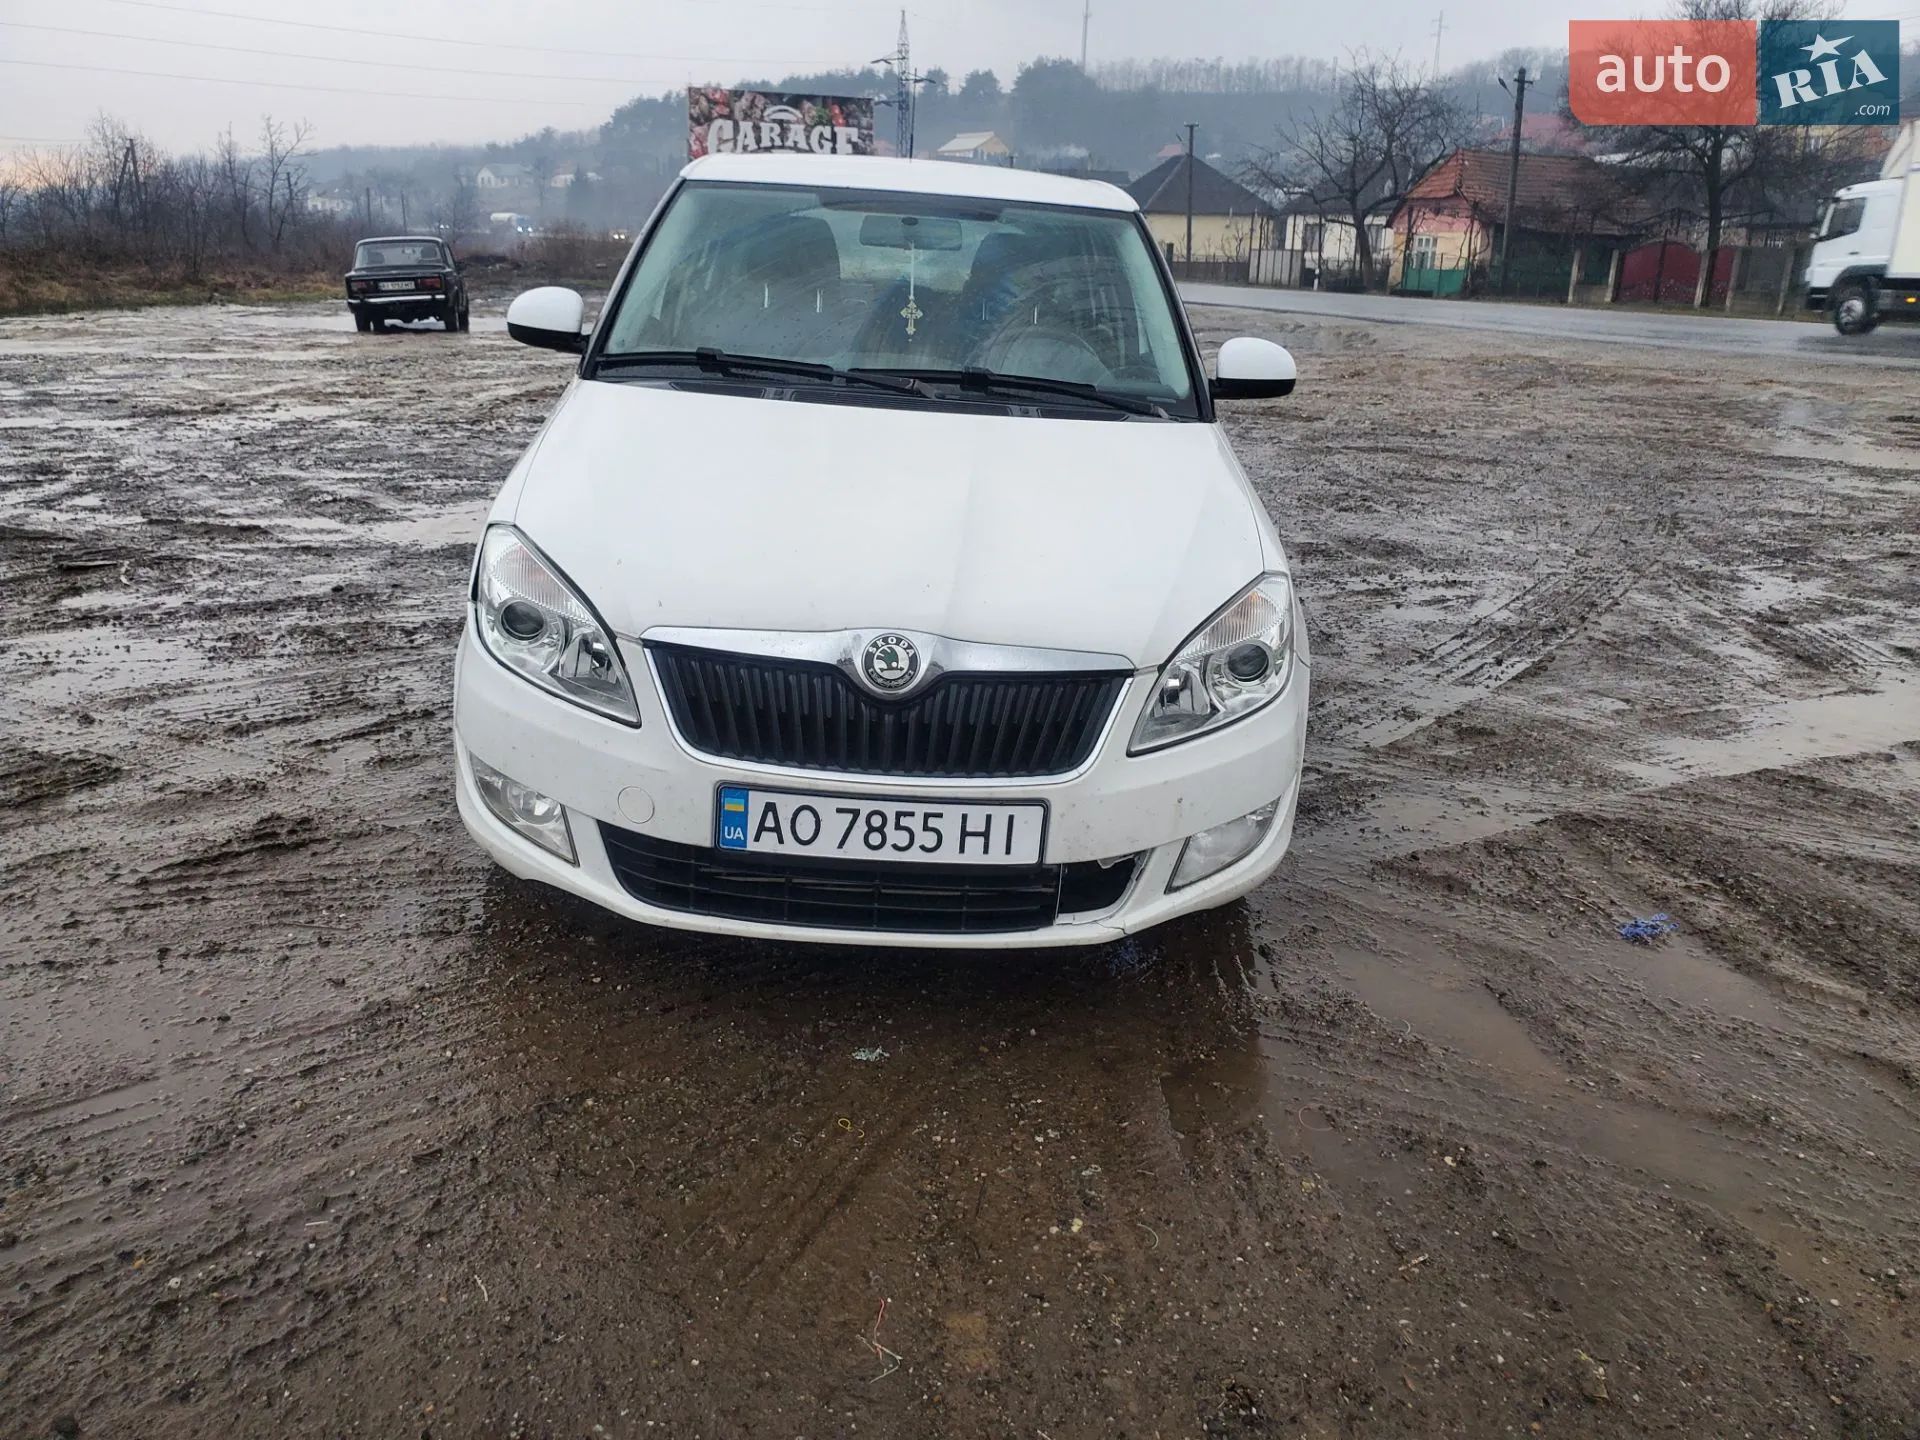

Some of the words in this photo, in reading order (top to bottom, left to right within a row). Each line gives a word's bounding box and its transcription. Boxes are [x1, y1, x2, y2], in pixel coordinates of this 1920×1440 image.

[707, 118, 859, 155] GARAGE
[724, 825, 745, 841] UA
[753, 801, 822, 846] AO
[835, 806, 944, 853] 7855
[958, 812, 1015, 856] HI
